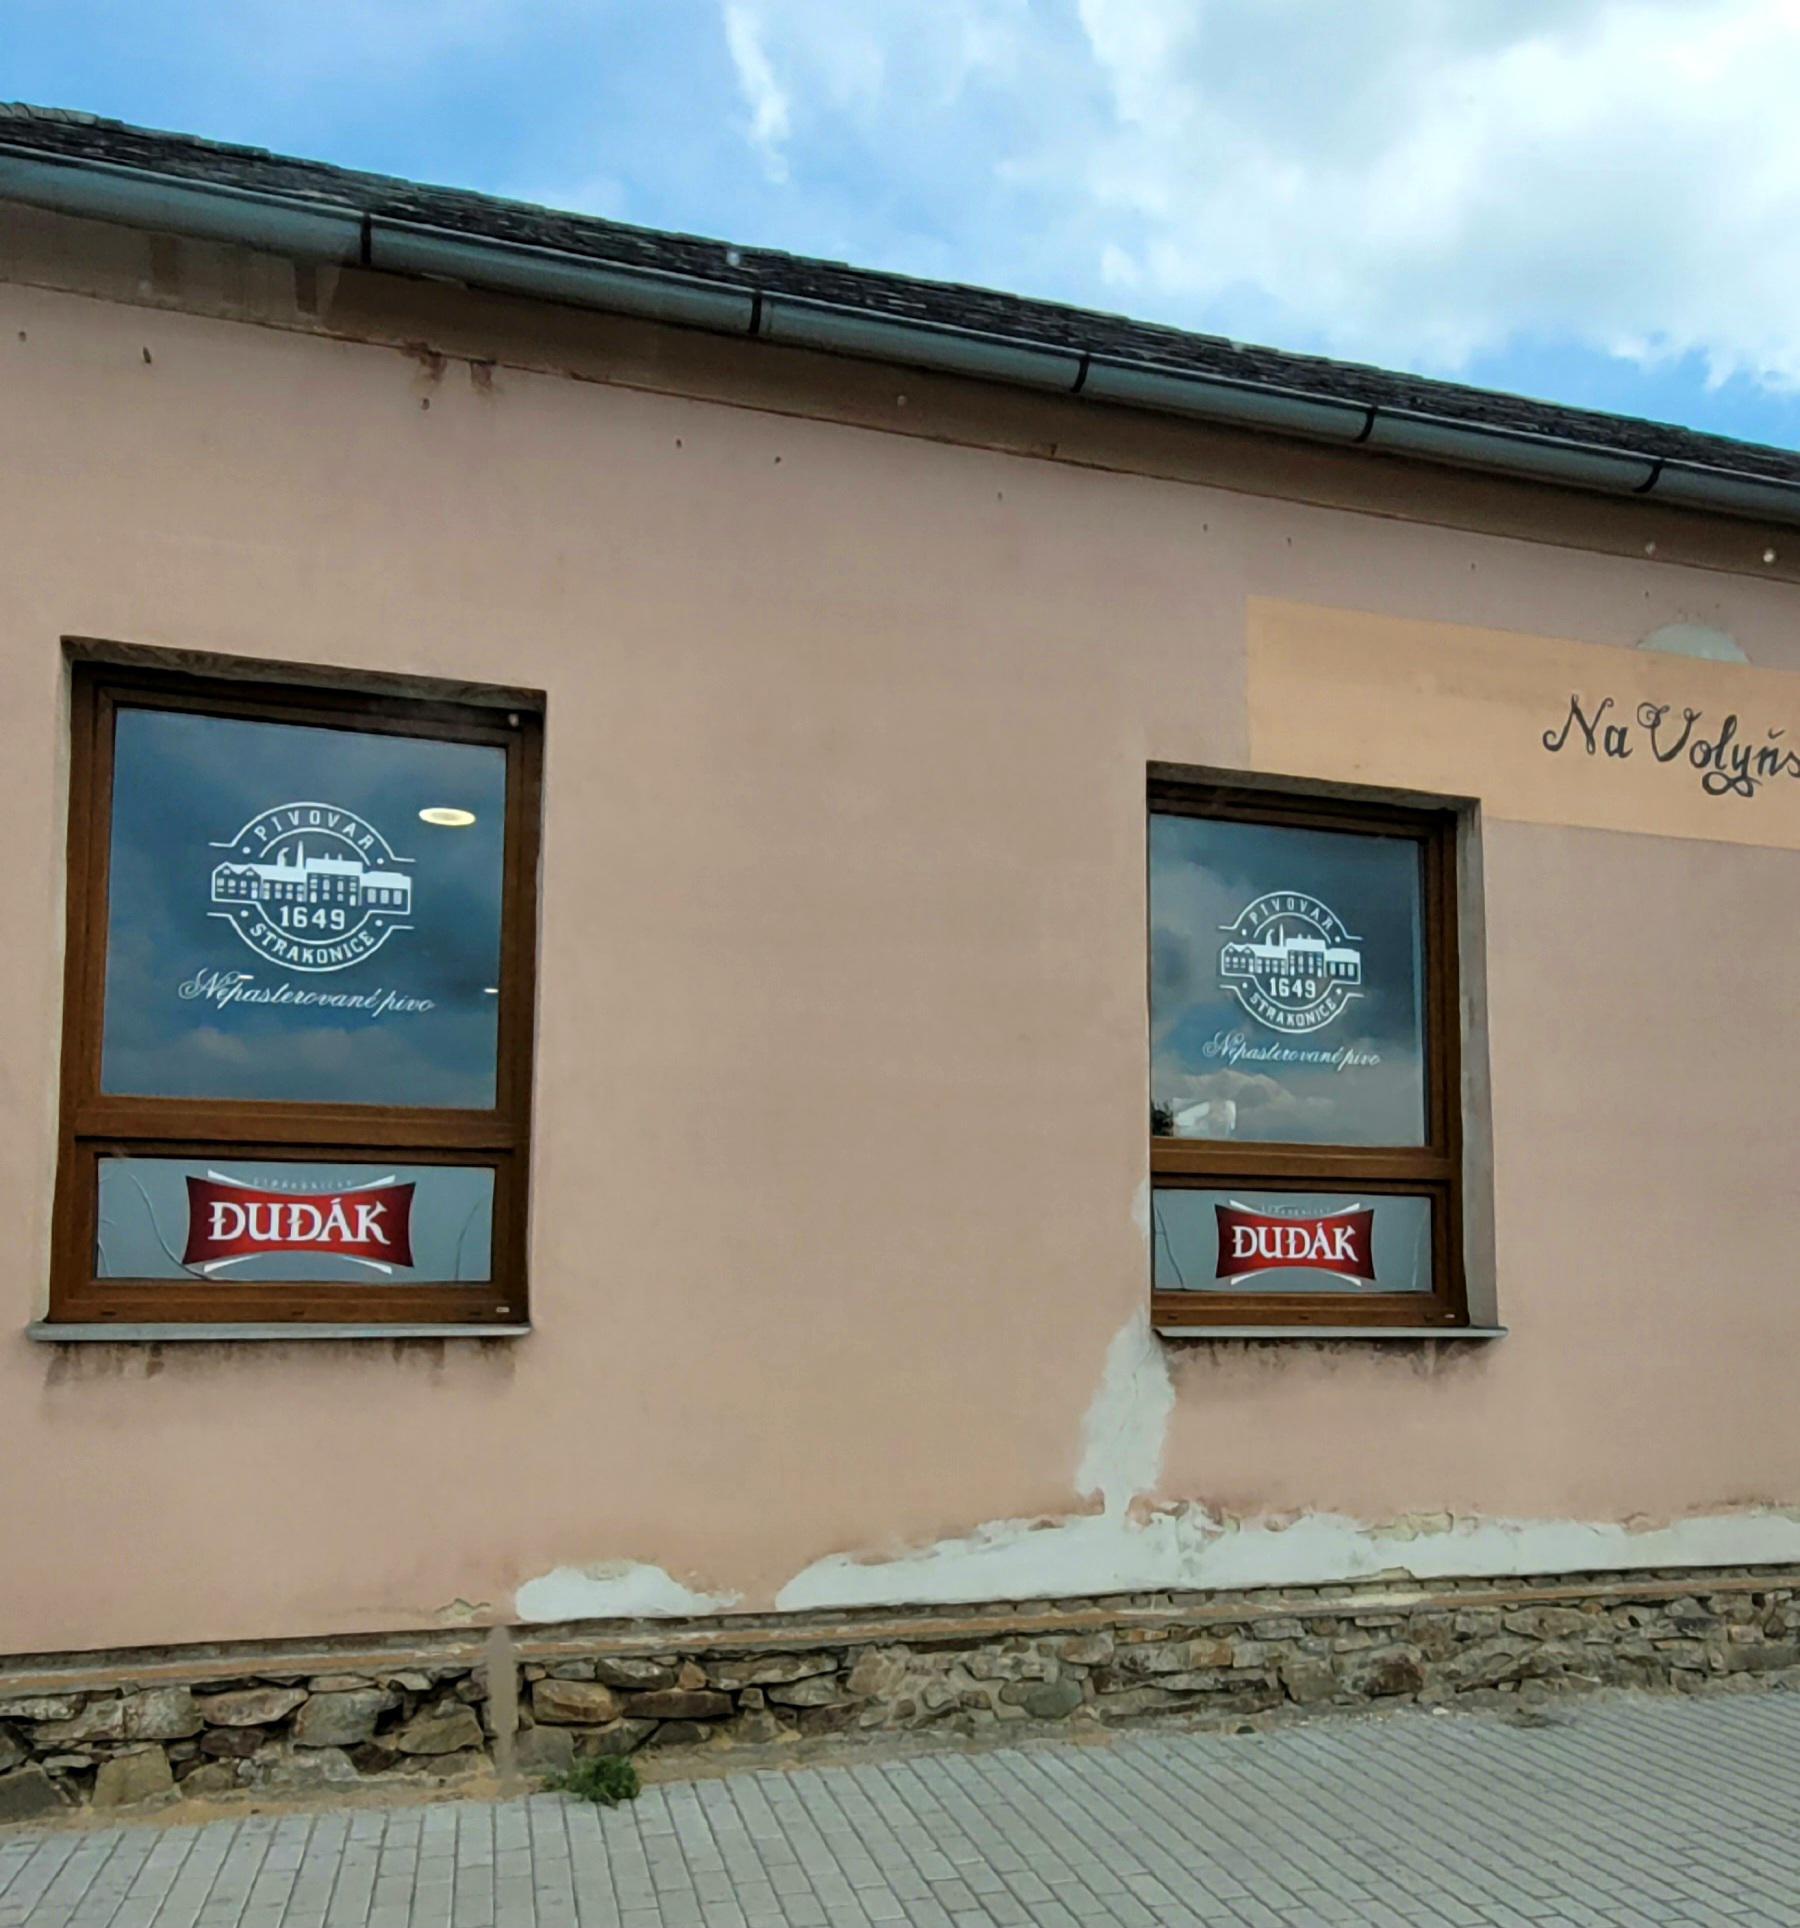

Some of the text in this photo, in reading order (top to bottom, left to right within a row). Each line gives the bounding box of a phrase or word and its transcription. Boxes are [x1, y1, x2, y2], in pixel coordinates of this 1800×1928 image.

[1543, 693, 1633, 759] Na
[254, 810, 375, 850] PIVOVAR
[279, 905, 345, 930] 1649
[1249, 897, 1334, 930] PIVOVAR
[250, 923, 375, 964] STRAKONICE
[1270, 977, 1316, 998] 1649
[371, 991, 435, 1018] pivo
[1249, 992, 1337, 1027] STRAKONICE
[1338, 1049, 1381, 1071] pivo
